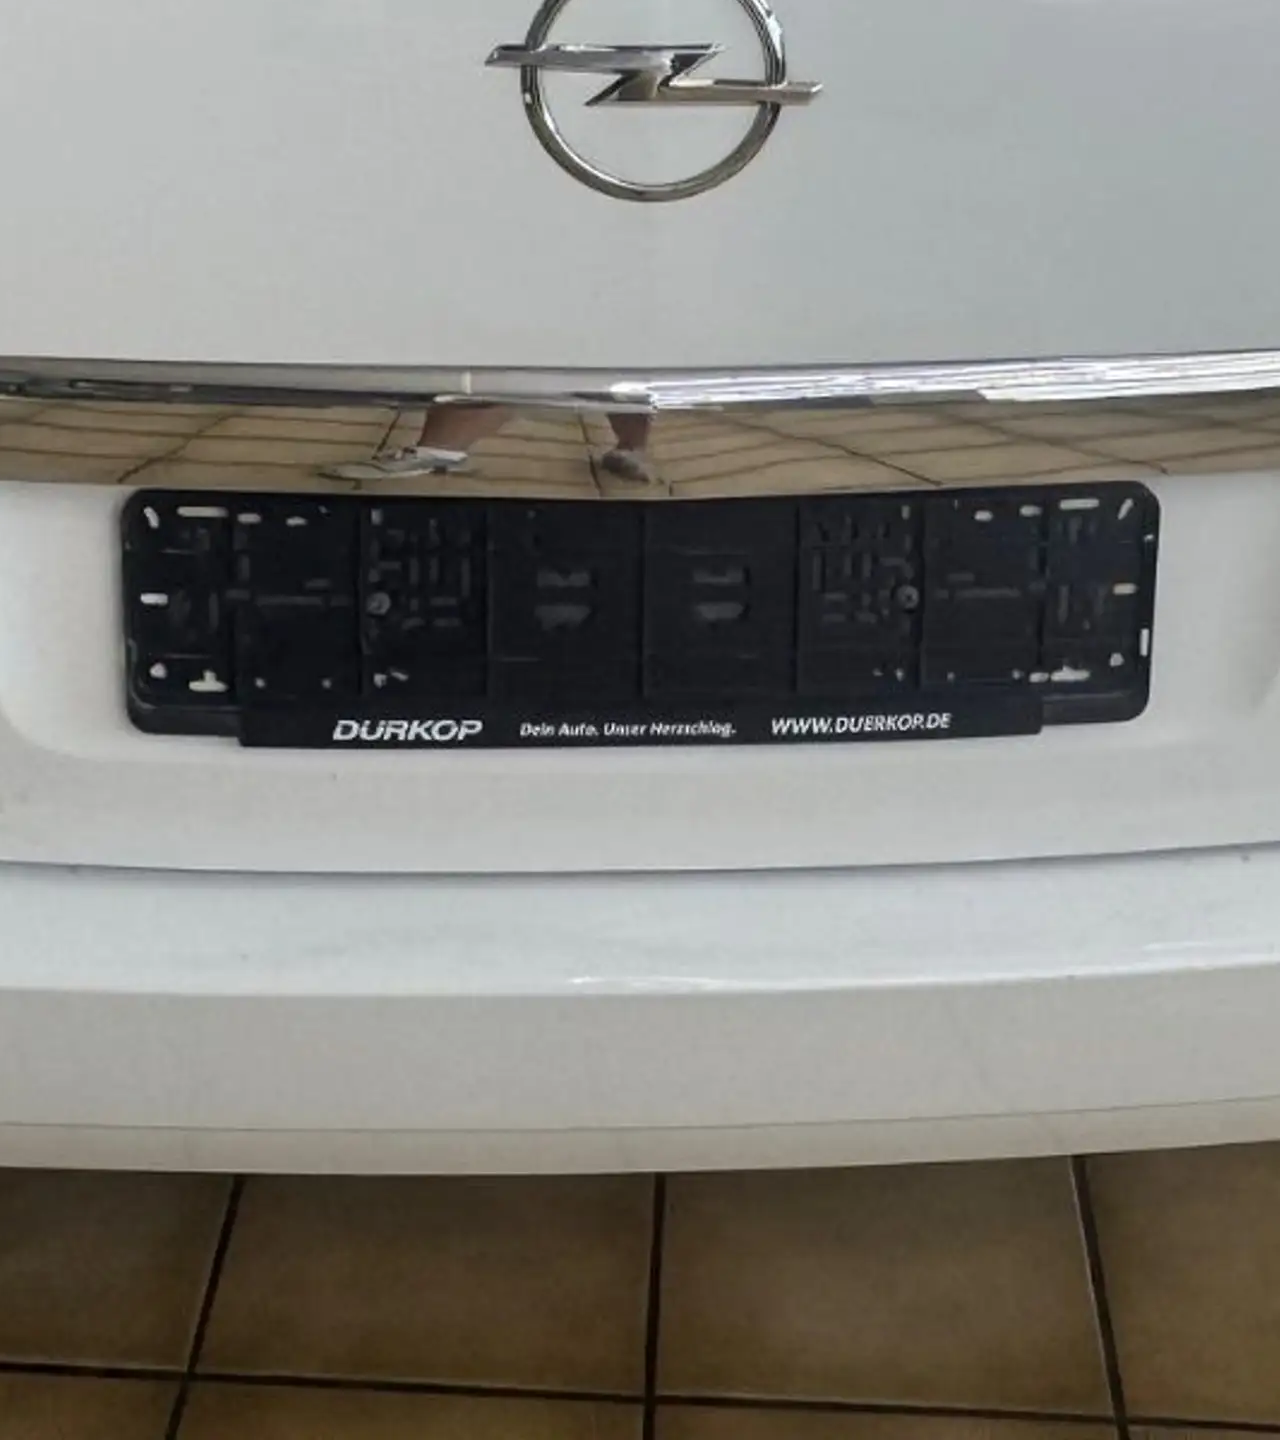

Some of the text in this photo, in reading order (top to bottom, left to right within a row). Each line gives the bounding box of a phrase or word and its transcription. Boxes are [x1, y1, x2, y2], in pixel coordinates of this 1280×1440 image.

[520, 721, 555, 737] Dein
[603, 721, 648, 737] Unser
[771, 713, 952, 735] WWW.DUERKOP.DE
